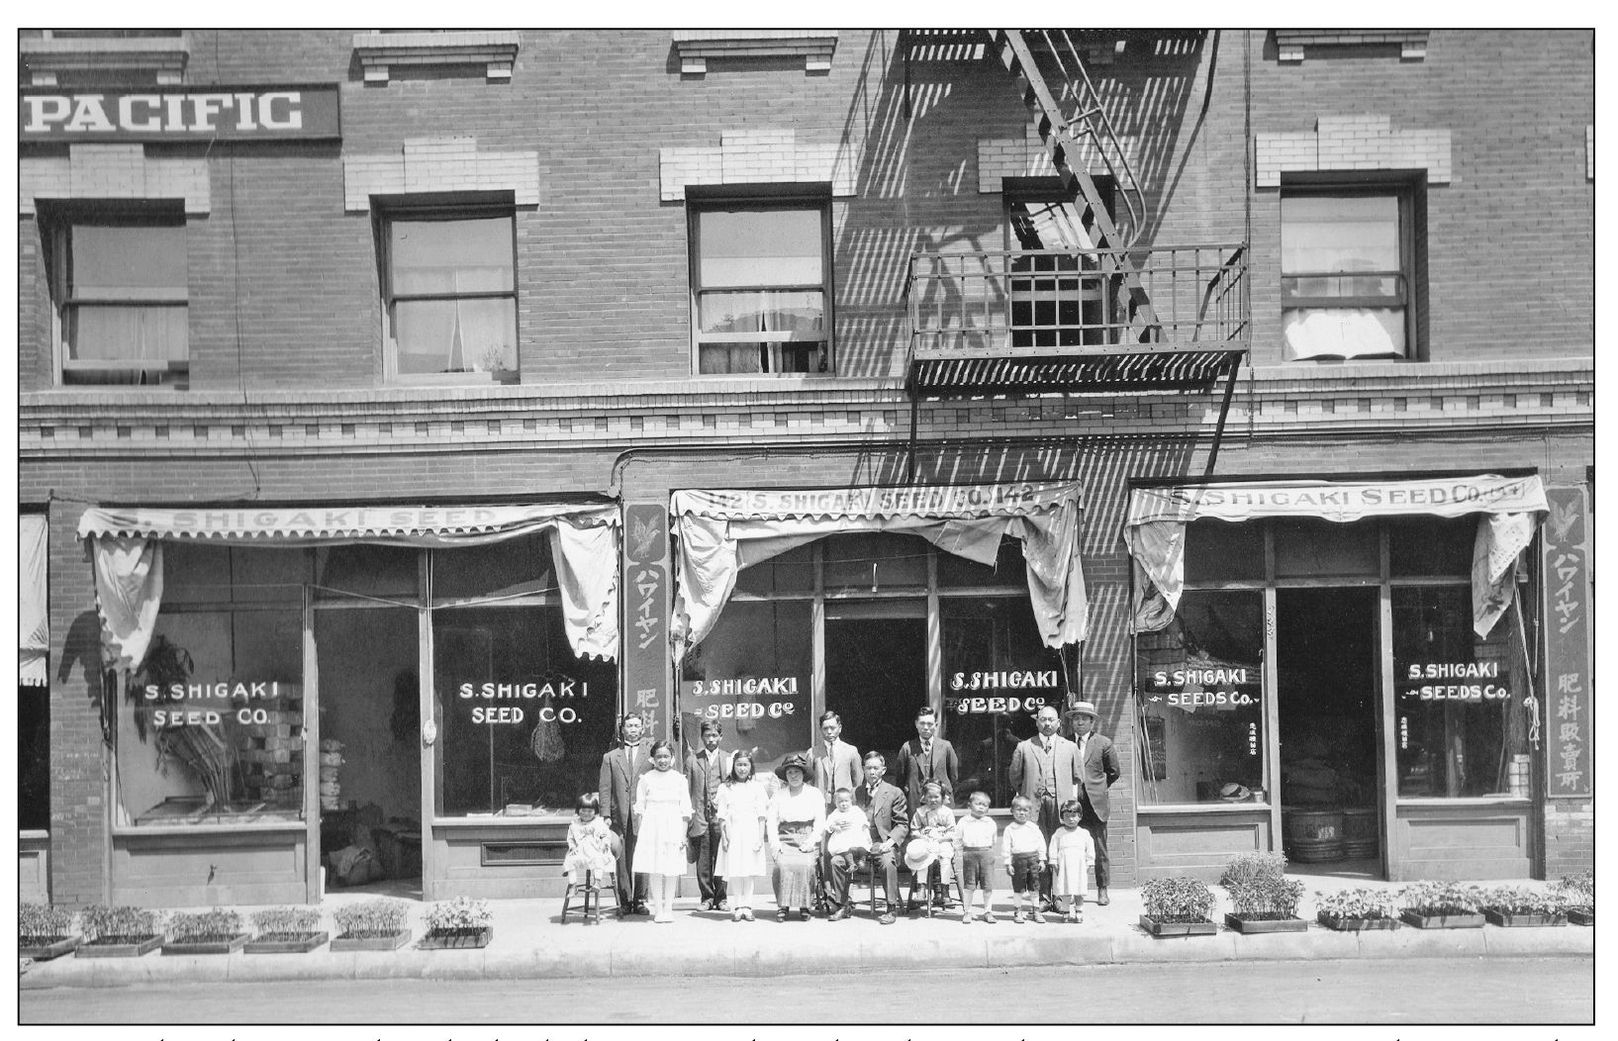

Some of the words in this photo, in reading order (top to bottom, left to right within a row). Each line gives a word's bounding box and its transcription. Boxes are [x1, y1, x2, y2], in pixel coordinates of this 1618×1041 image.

[23, 92, 302, 132] PACIFIC
[880, 491, 944, 510] SEED
[997, 485, 1034, 504] 142
[1361, 488, 1447, 505] SEED
[173, 511, 365, 528] SHIGAKI
[391, 509, 497, 526] SEED
[1552, 553, 1580, 634] ハワイヤン
[633, 569, 660, 649] ハワイヤン
[1167, 692, 1228, 706] SEEDS
[1420, 684, 1482, 700] SEEDS
[471, 706, 525, 724] SEED
[538, 707, 583, 724] CO.
[704, 702, 766, 720] SEED
[957, 697, 1022, 715] SEED
[153, 709, 221, 727] SEED
[236, 707, 271, 725] CO.
